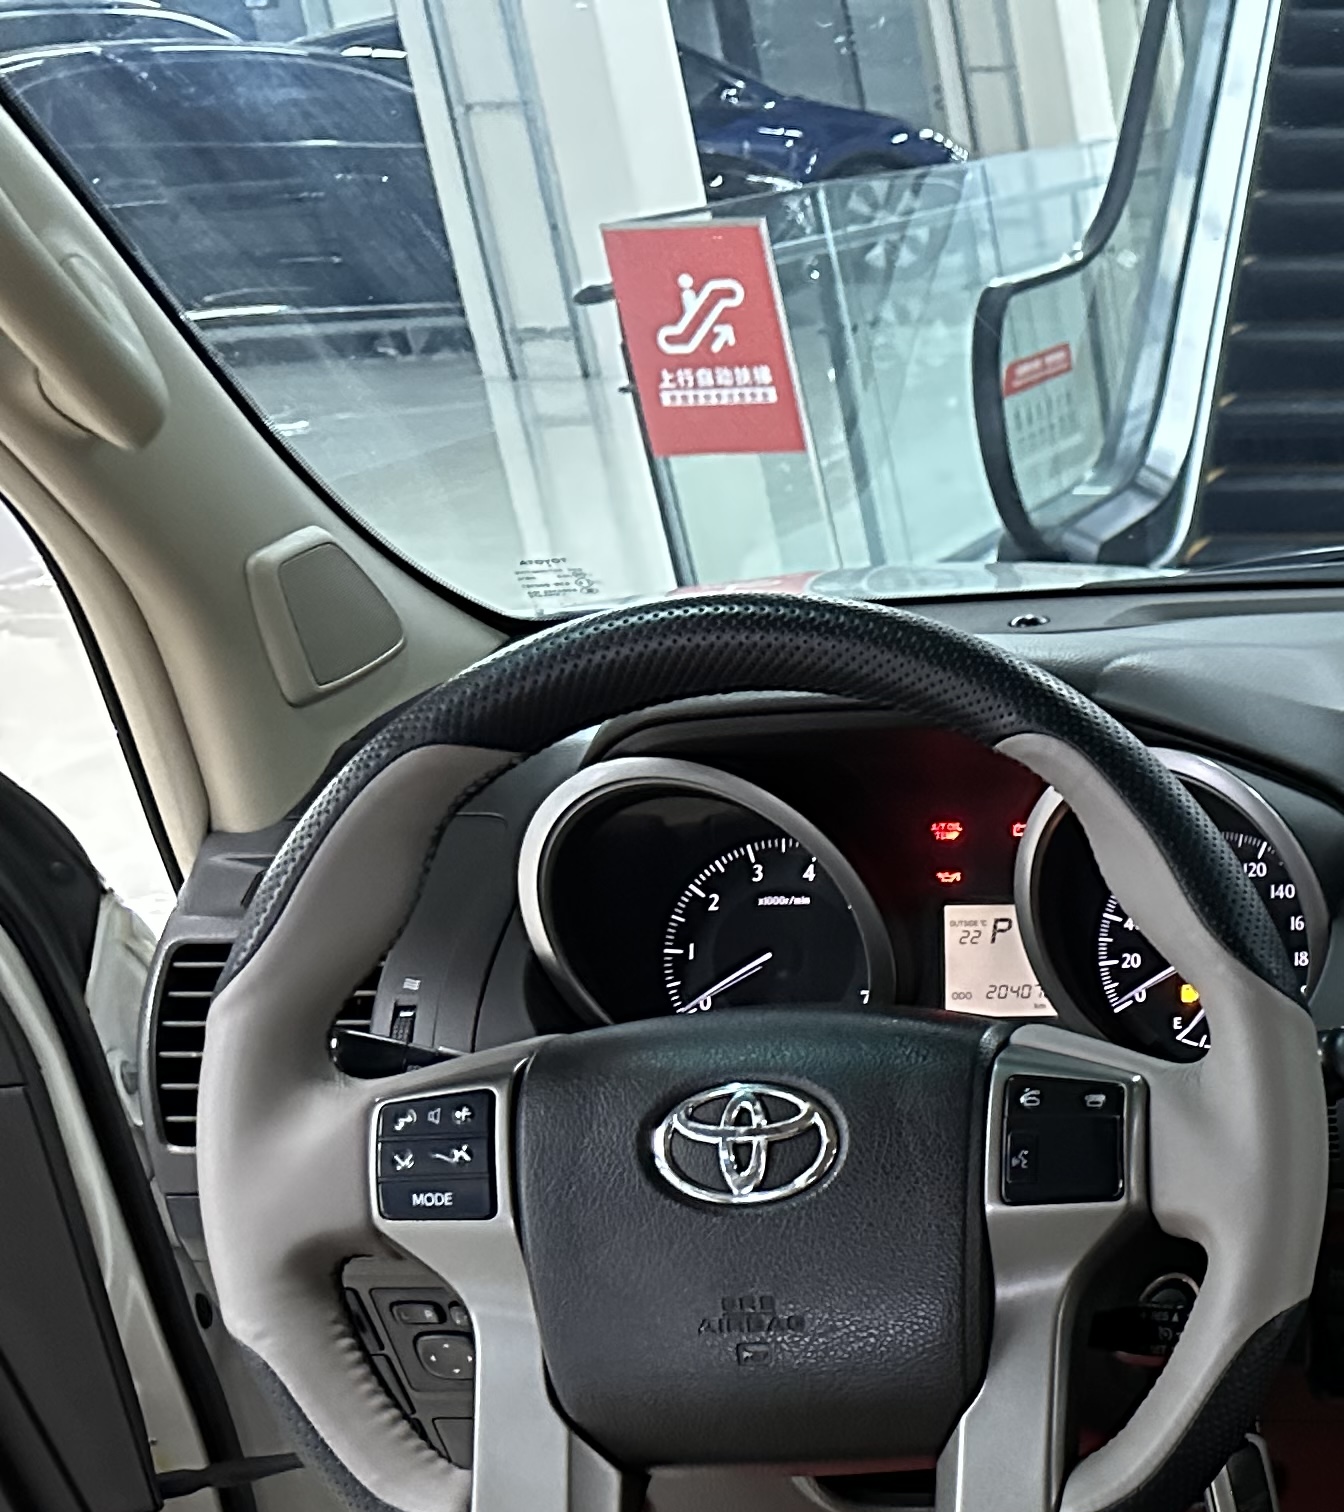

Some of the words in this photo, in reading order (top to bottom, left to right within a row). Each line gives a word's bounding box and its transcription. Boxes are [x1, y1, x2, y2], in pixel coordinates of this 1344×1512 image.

[659, 364, 774, 389] 上行自动扶梯
[752, 864, 763, 882] 3
[803, 864, 816, 882] 4
[1270, 884, 1296, 899] 140
[708, 893, 720, 911] 2
[990, 918, 1013, 944] P
[1123, 917, 1140, 931] 4
[1290, 915, 1305, 931] 16
[959, 930, 982, 944] 22
[688, 943, 694, 960] 1
[1294, 951, 1309, 966] 18
[1121, 953, 1142, 969] 20
[860, 990, 870, 1004] 7
[1173, 1017, 1182, 1030] E
[412, 1192, 453, 1206] MODE
